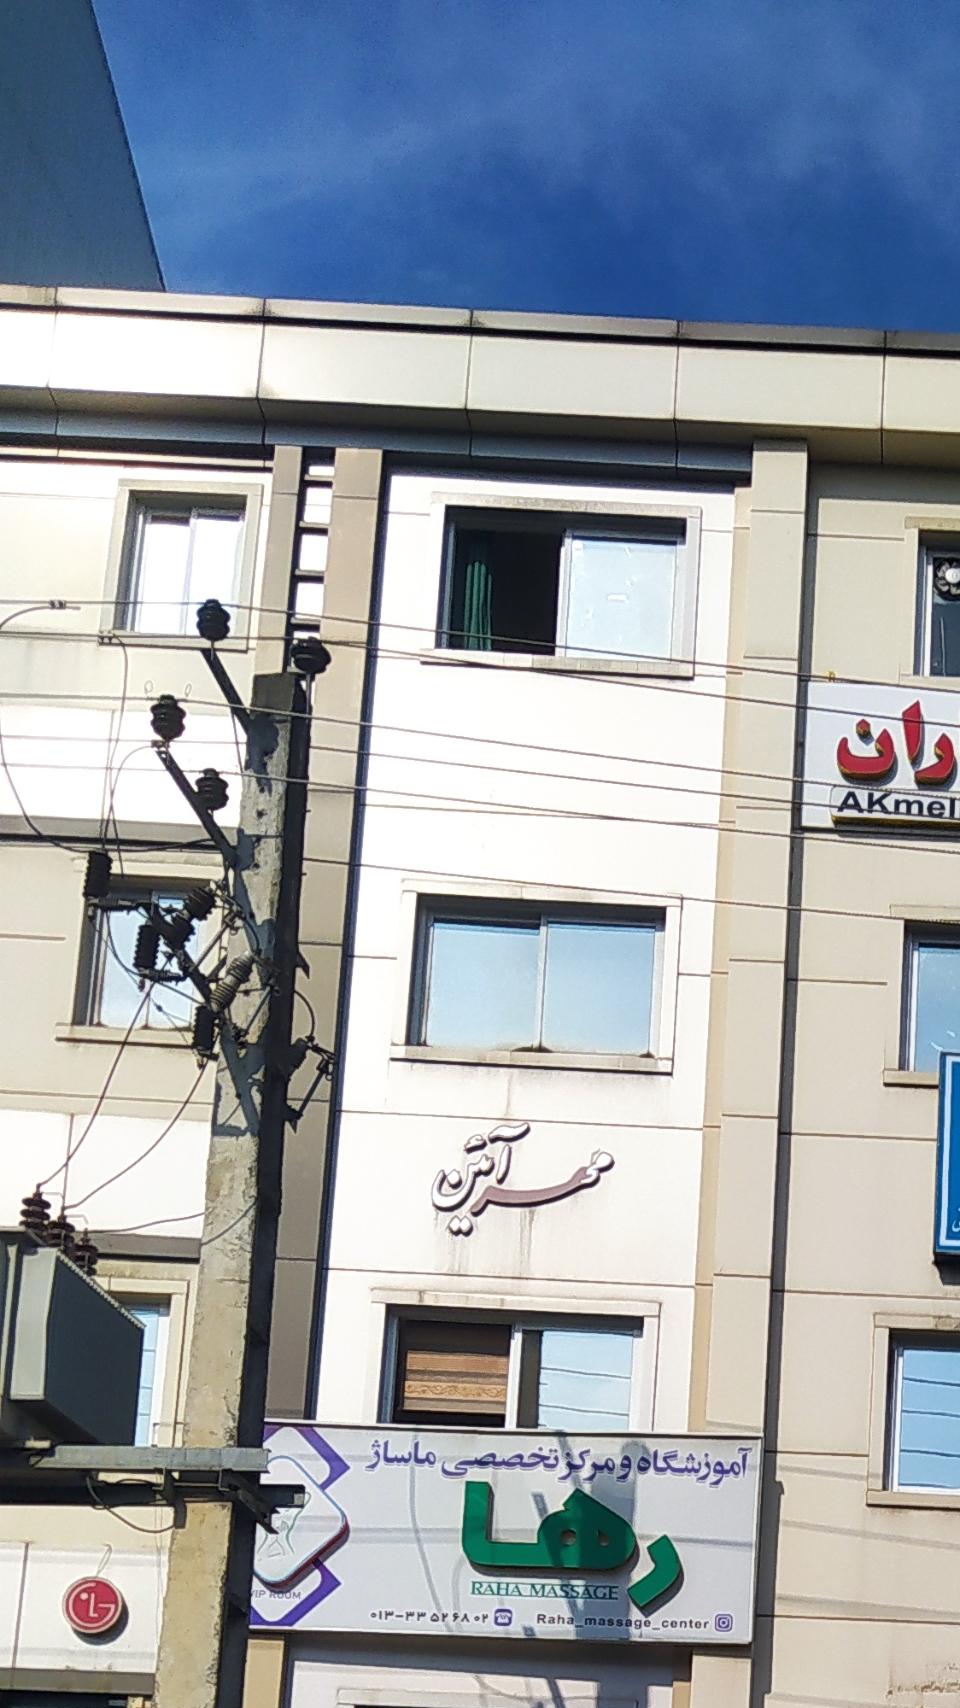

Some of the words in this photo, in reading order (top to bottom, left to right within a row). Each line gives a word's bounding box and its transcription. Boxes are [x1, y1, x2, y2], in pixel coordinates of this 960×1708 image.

[367, 1439, 436, 1472] ماساژ
[441, 1446, 560, 1480] تخصصی
[558, 1447, 620, 1482] مرکز
[619, 1455, 632, 1483] و
[637, 1447, 752, 1486] آموزشگاه
[462, 1480, 684, 1617] رها
[68, 1581, 116, 1628] LG
[470, 1580, 522, 1597] RAHA
[530, 1583, 619, 1600] MASSAGE
[536, 1613, 710, 1631] Raha_massage_center
